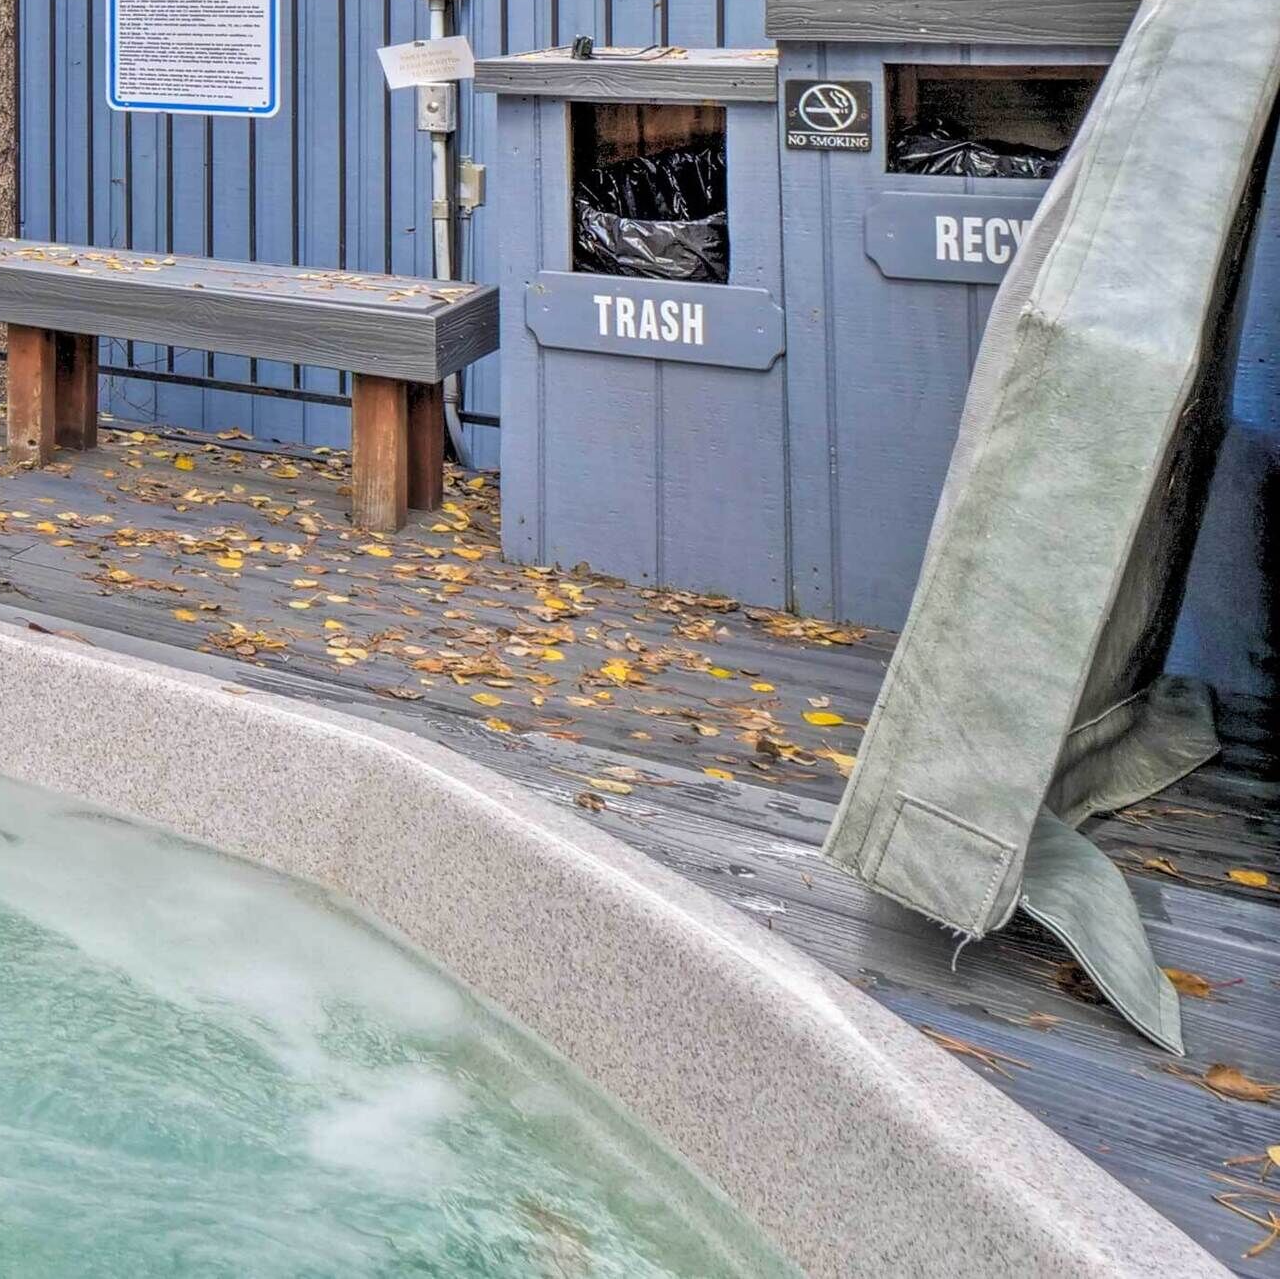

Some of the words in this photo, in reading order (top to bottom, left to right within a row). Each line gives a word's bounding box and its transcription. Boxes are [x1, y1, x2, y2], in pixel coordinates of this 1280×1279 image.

[788, 135, 807, 146] NO
[809, 135, 869, 148] SMOKING
[593, 295, 703, 345] TRASH
